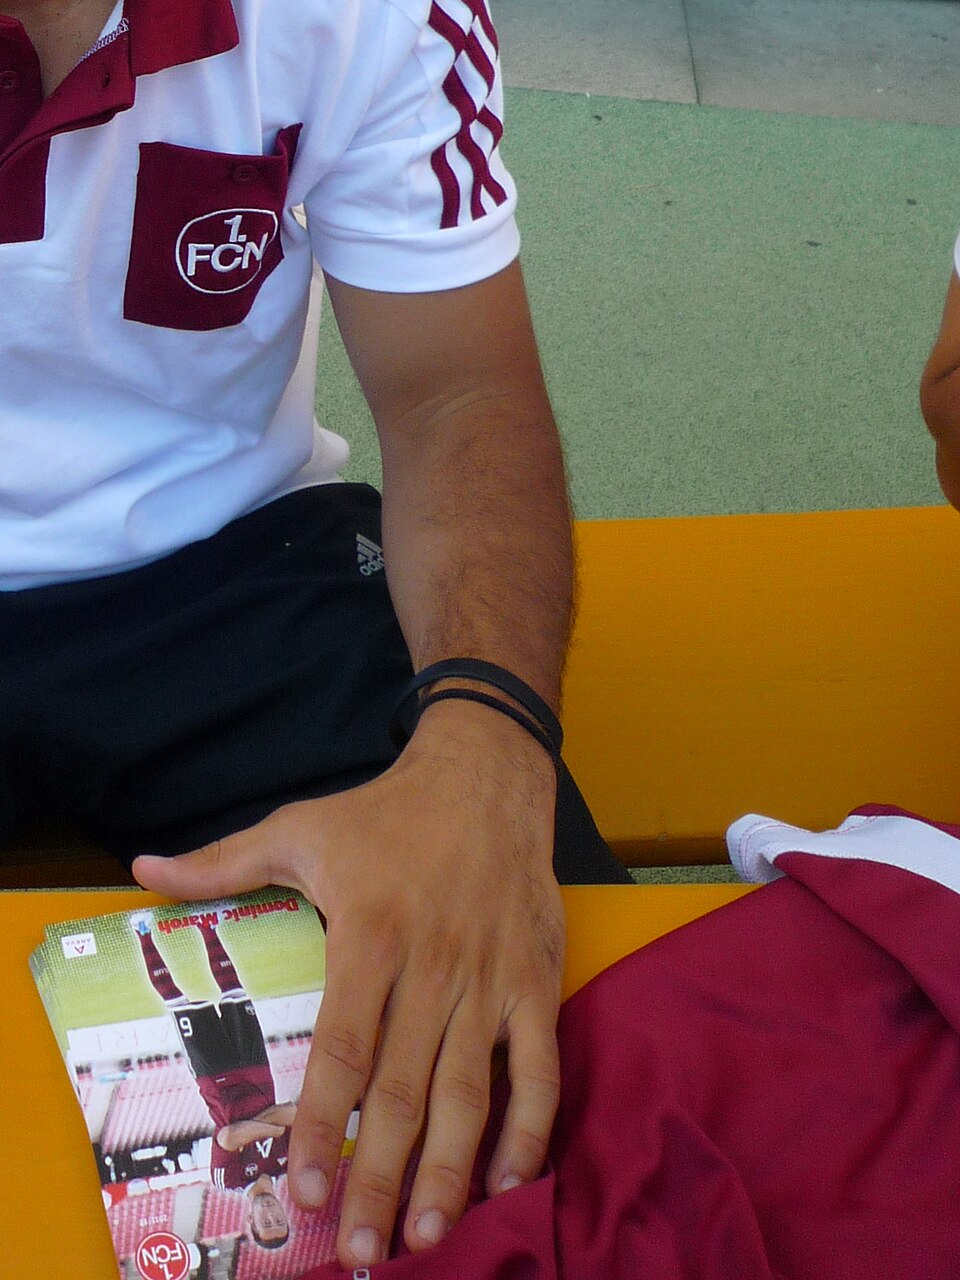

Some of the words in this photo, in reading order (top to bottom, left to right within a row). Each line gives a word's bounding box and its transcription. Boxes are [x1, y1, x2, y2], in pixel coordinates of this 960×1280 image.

[224, 214, 248, 243] 1.
[187, 232, 269, 276] FCN
[222, 898, 300, 923] Dominic
[157, 912, 219, 935] Maroh
[178, 1016, 193, 1037] 6
[141, 1241, 183, 1266] FCN
